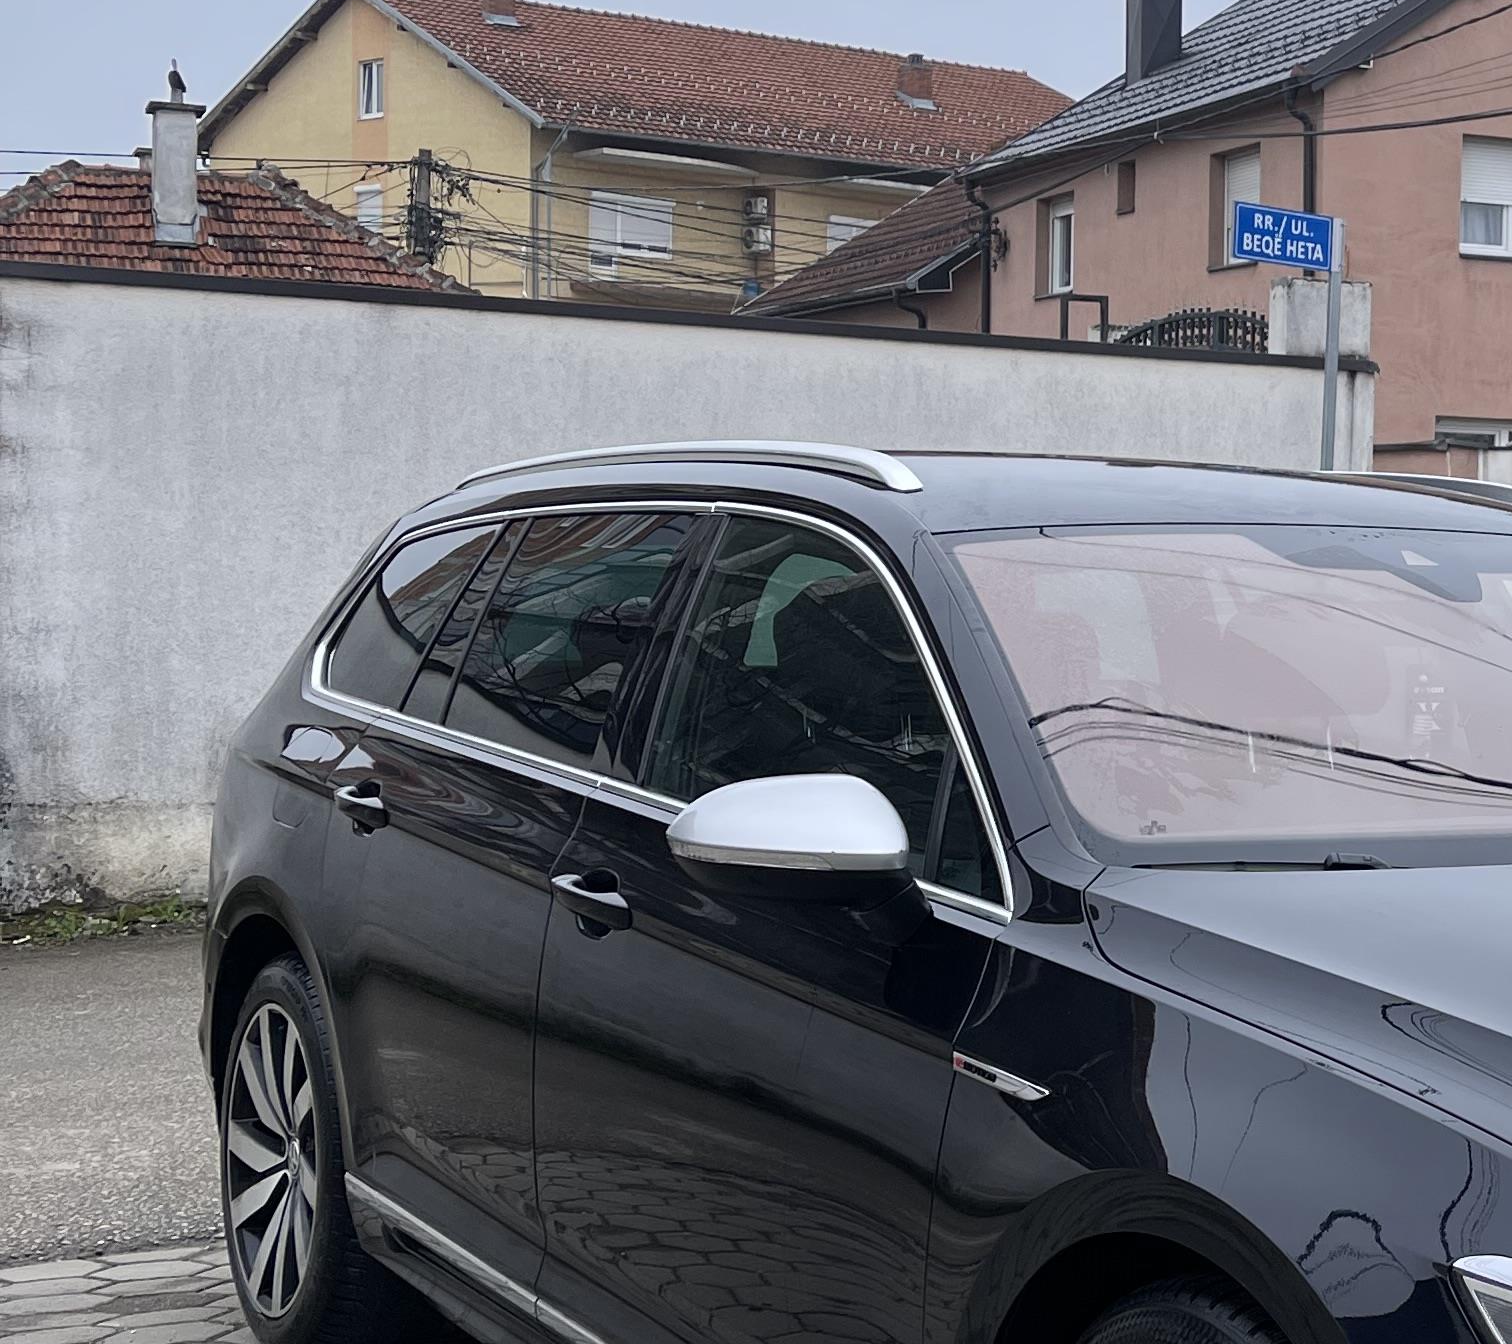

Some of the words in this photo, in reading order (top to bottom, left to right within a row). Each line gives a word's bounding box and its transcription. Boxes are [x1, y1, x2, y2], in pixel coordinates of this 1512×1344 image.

[1291, 219, 1314, 237] UL.
[1243, 232, 1282, 256] BEQË
[1286, 239, 1324, 262] HETA
